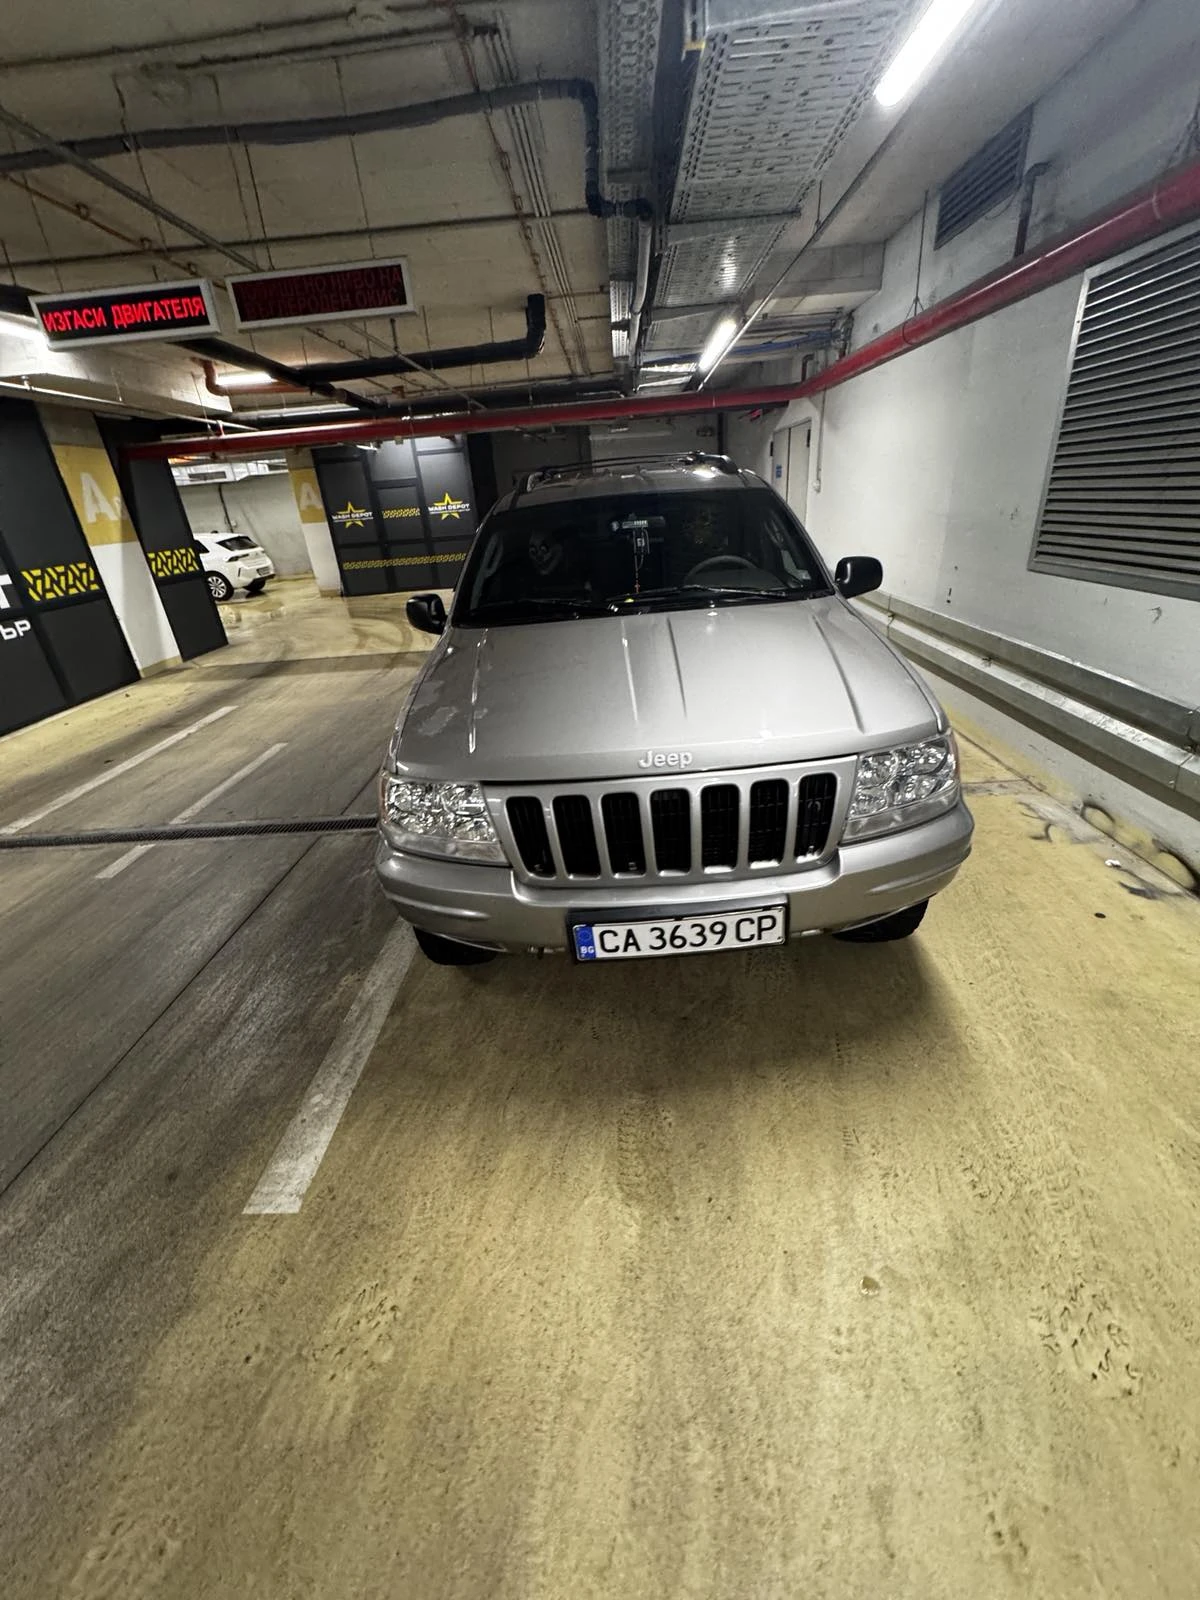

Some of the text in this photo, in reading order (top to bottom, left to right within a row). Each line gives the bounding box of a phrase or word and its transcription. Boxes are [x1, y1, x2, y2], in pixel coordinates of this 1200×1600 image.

[42, 295, 205, 332] ИЗГАСИ ДВИГАТЕЛЯ
[638, 750, 693, 769] Jeep
[599, 914, 777, 953] CA 3639 CP
[580, 945, 595, 955] BG
